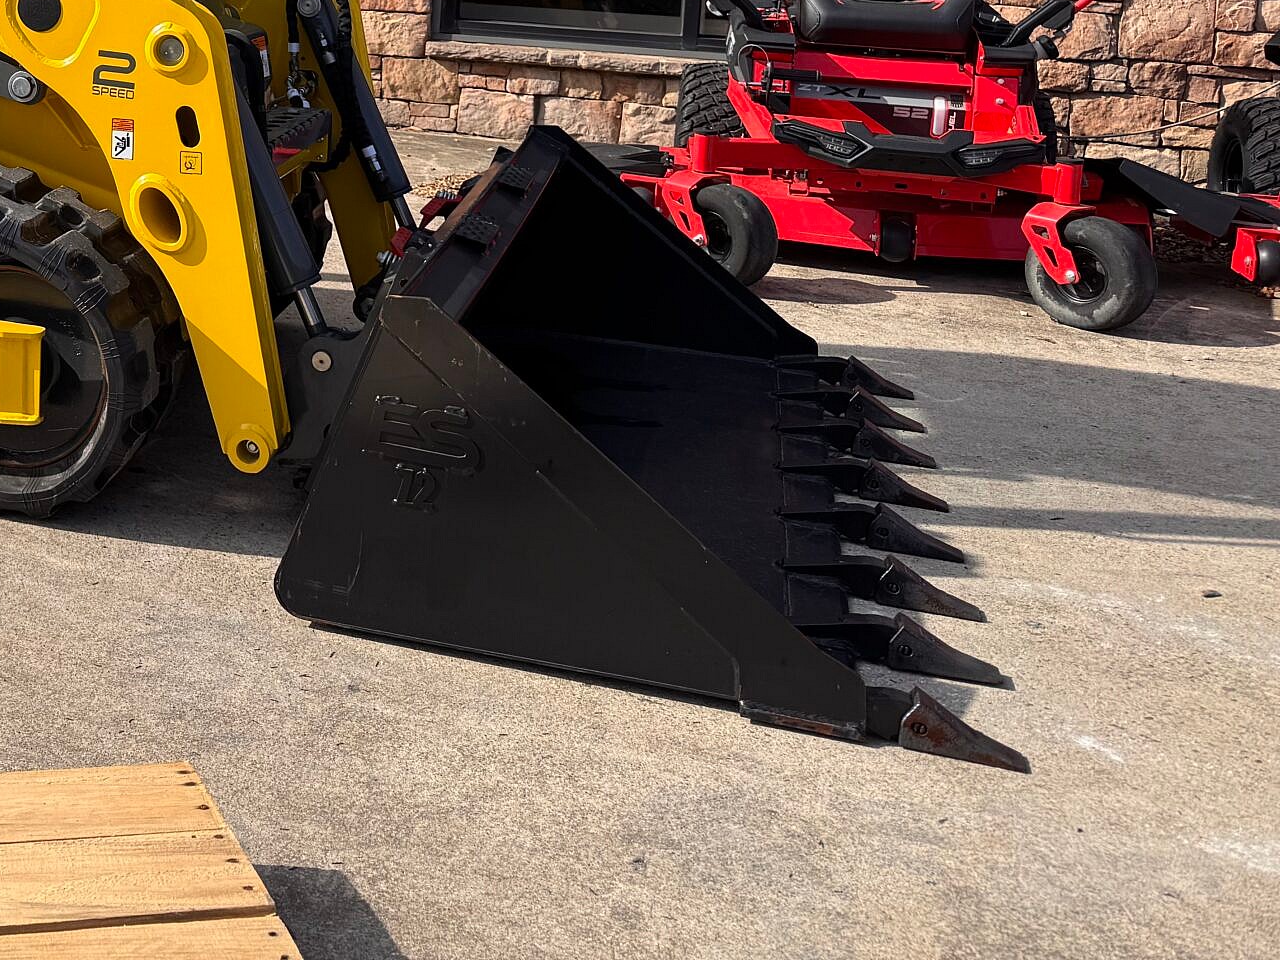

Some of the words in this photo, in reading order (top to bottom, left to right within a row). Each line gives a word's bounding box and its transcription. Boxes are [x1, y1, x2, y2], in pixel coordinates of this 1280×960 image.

[93, 50, 136, 89] 2
[92, 86, 134, 100] SPEED
[948, 112, 956, 130] UEL
